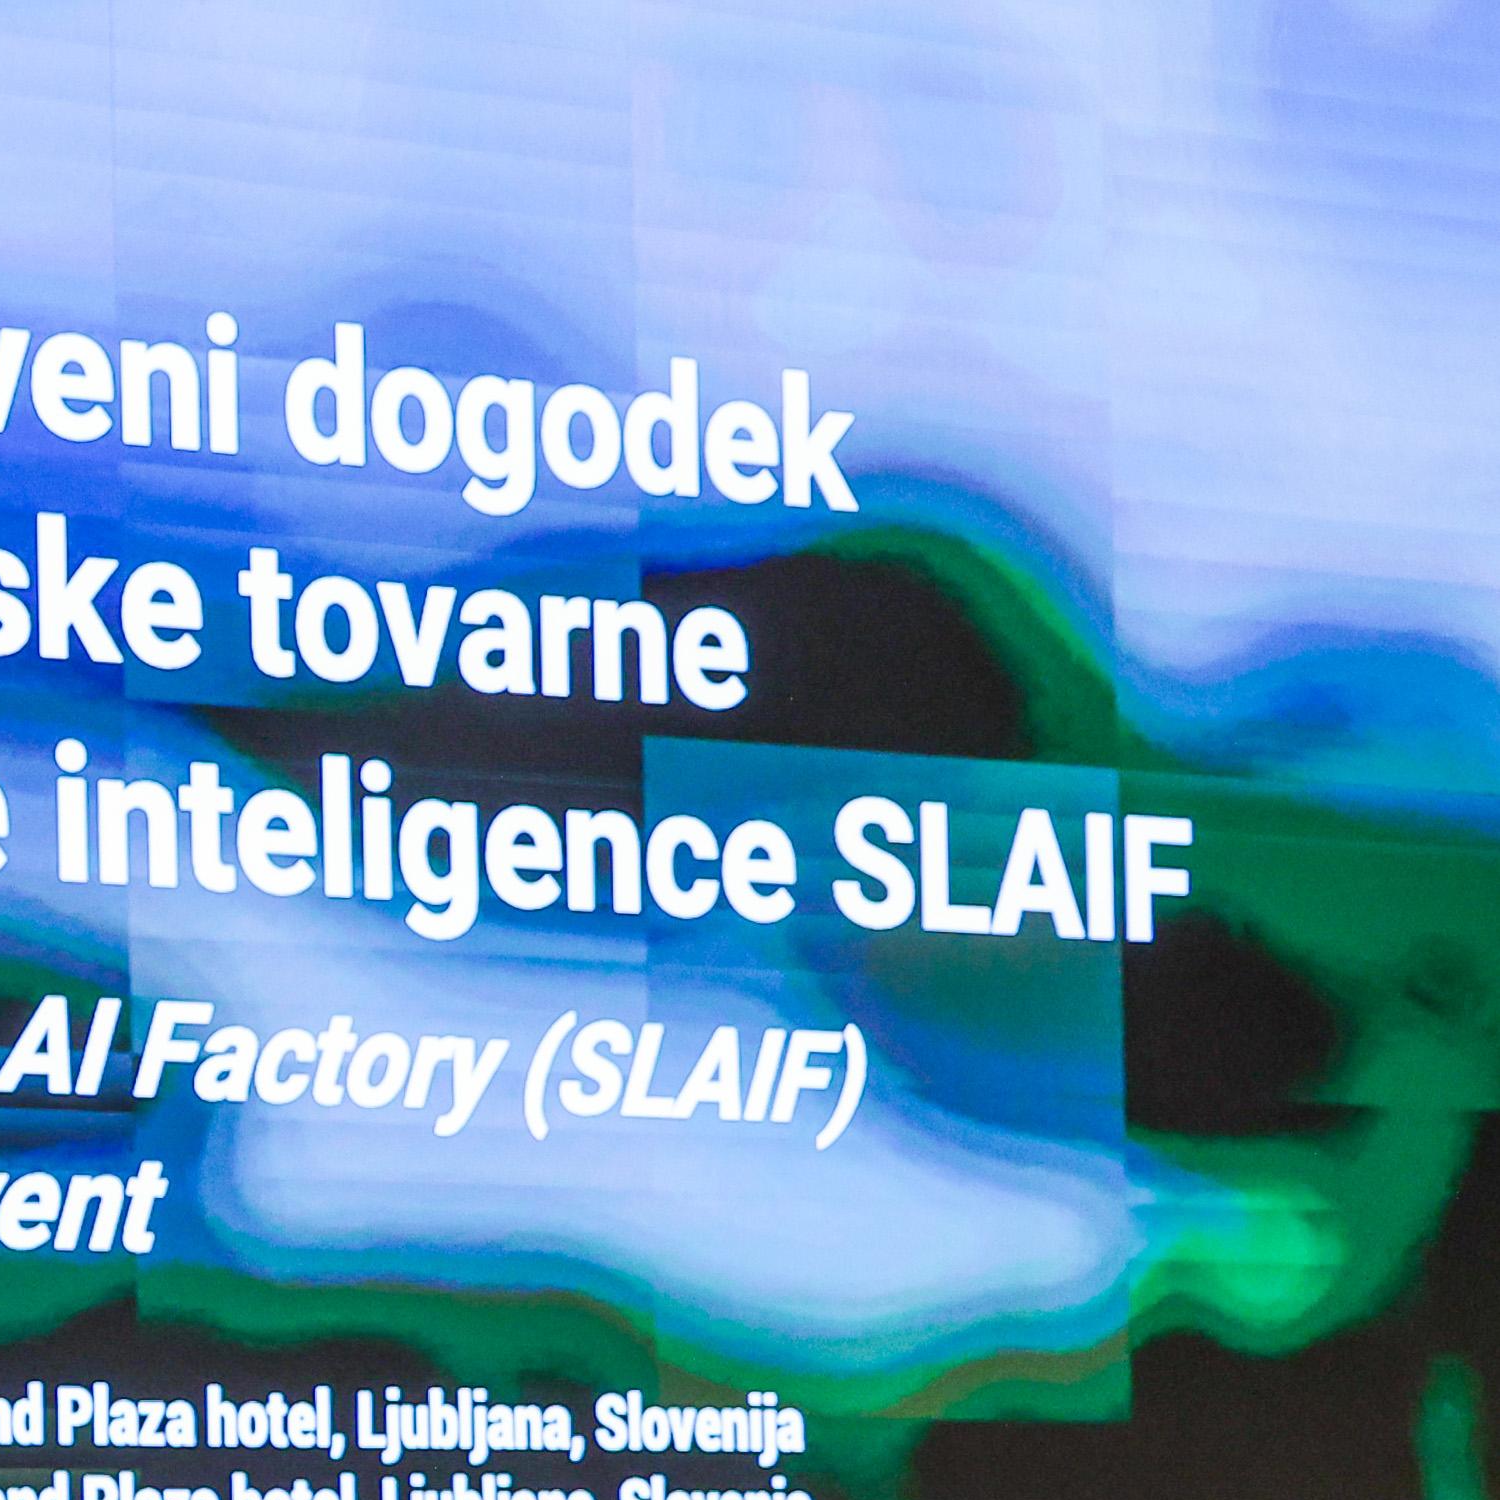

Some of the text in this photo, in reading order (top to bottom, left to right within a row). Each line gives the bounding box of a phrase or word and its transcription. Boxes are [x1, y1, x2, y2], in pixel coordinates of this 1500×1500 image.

[284, 321, 860, 517] dogodek
[238, 546, 750, 711] tovarne
[53, 738, 797, 942] inteligence
[831, 795, 1194, 944] SLAIF
[132, 998, 510, 1137] Factory
[523, 1009, 867, 1151] (SLAIF)
[55, 1381, 197, 1449] Plaza
[206, 1382, 346, 1461] hotel,
[356, 1386, 586, 1466] Ljubljana,
[594, 1389, 805, 1468] Slovenija
